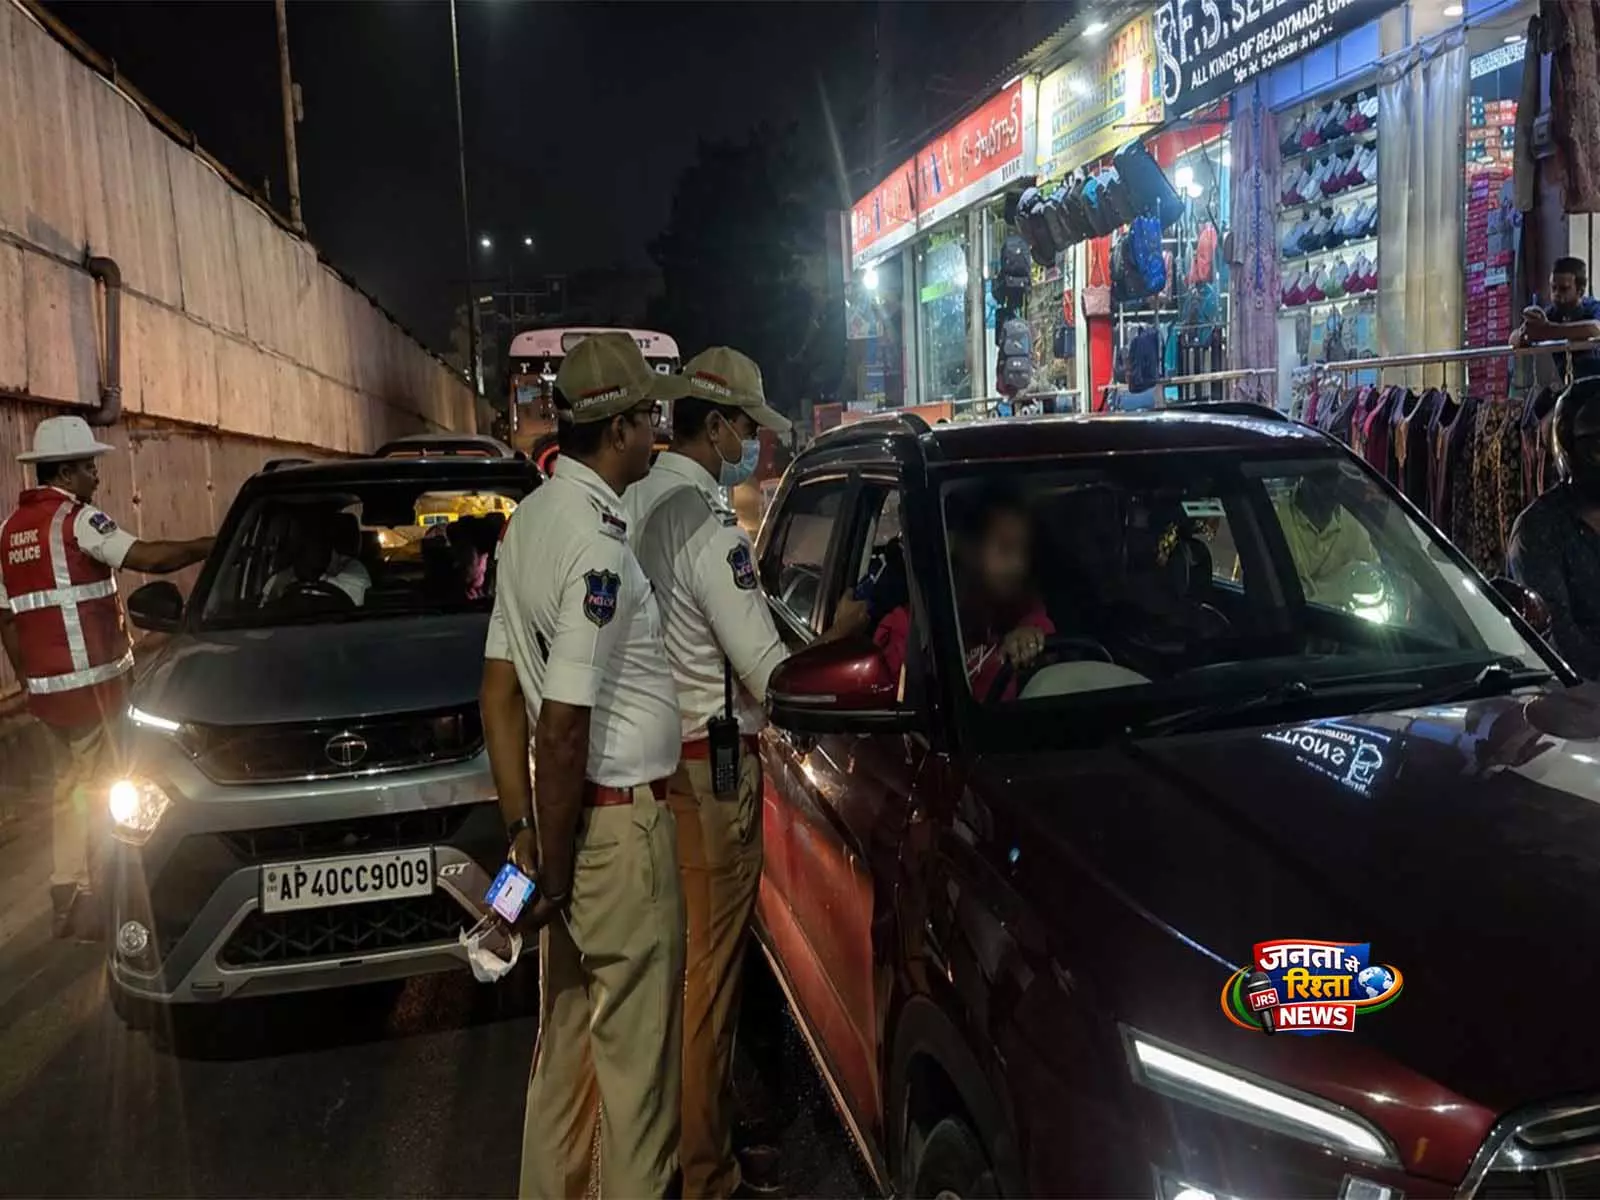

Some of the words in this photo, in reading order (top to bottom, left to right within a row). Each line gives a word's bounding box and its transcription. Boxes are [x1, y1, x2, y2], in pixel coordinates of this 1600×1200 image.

[1191, 65, 1208, 90] ALL
[1209, 47, 1238, 79] KINDS
[1239, 36, 1255, 61] OF
[1256, 0, 1325, 53] READYMADE
[8, 544, 41, 565] POLICE
[439, 862, 472, 877] GT
